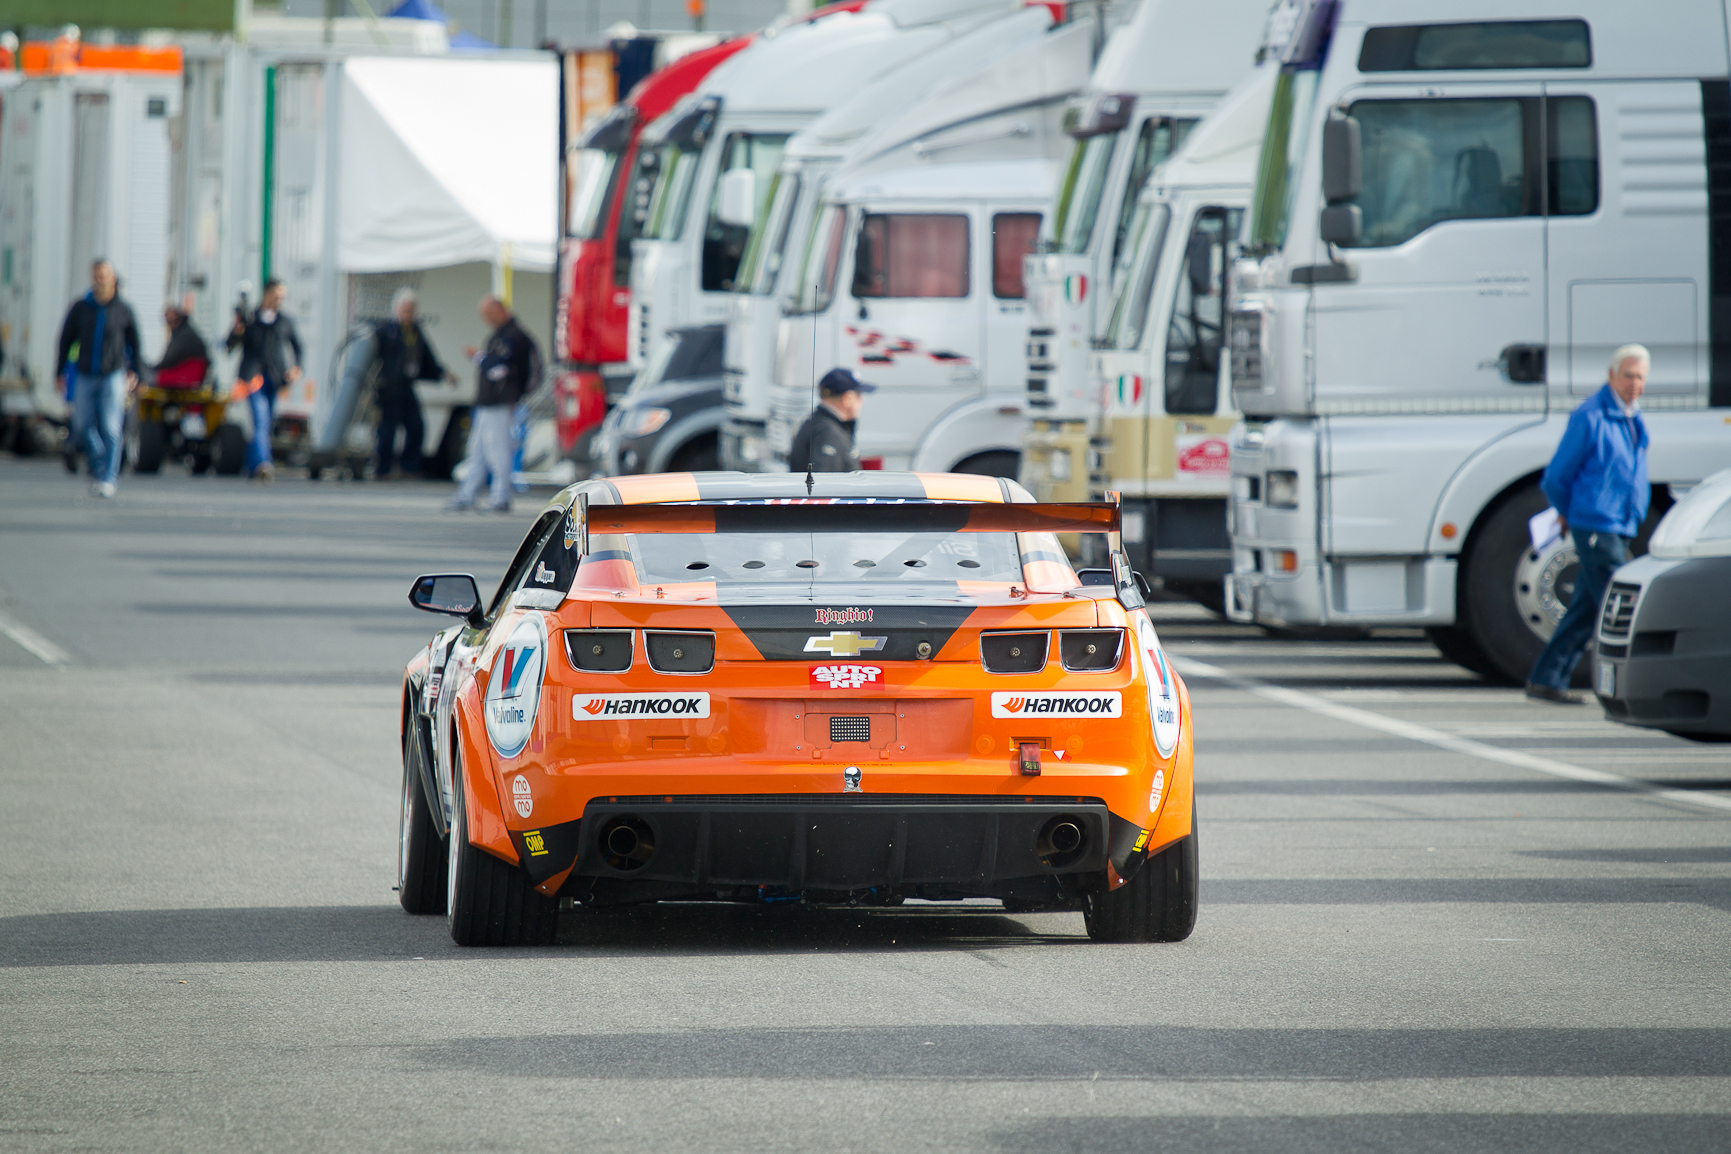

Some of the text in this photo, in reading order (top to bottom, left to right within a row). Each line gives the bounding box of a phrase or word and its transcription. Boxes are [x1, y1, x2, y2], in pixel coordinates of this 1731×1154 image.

[815, 607, 873, 625] Ringhio!
[812, 665, 882, 675] AUTO
[816, 673, 876, 682] SPRI
[830, 680, 864, 688] NT
[493, 707, 524, 723] Valvoline
[526, 835, 544, 851] OMP
